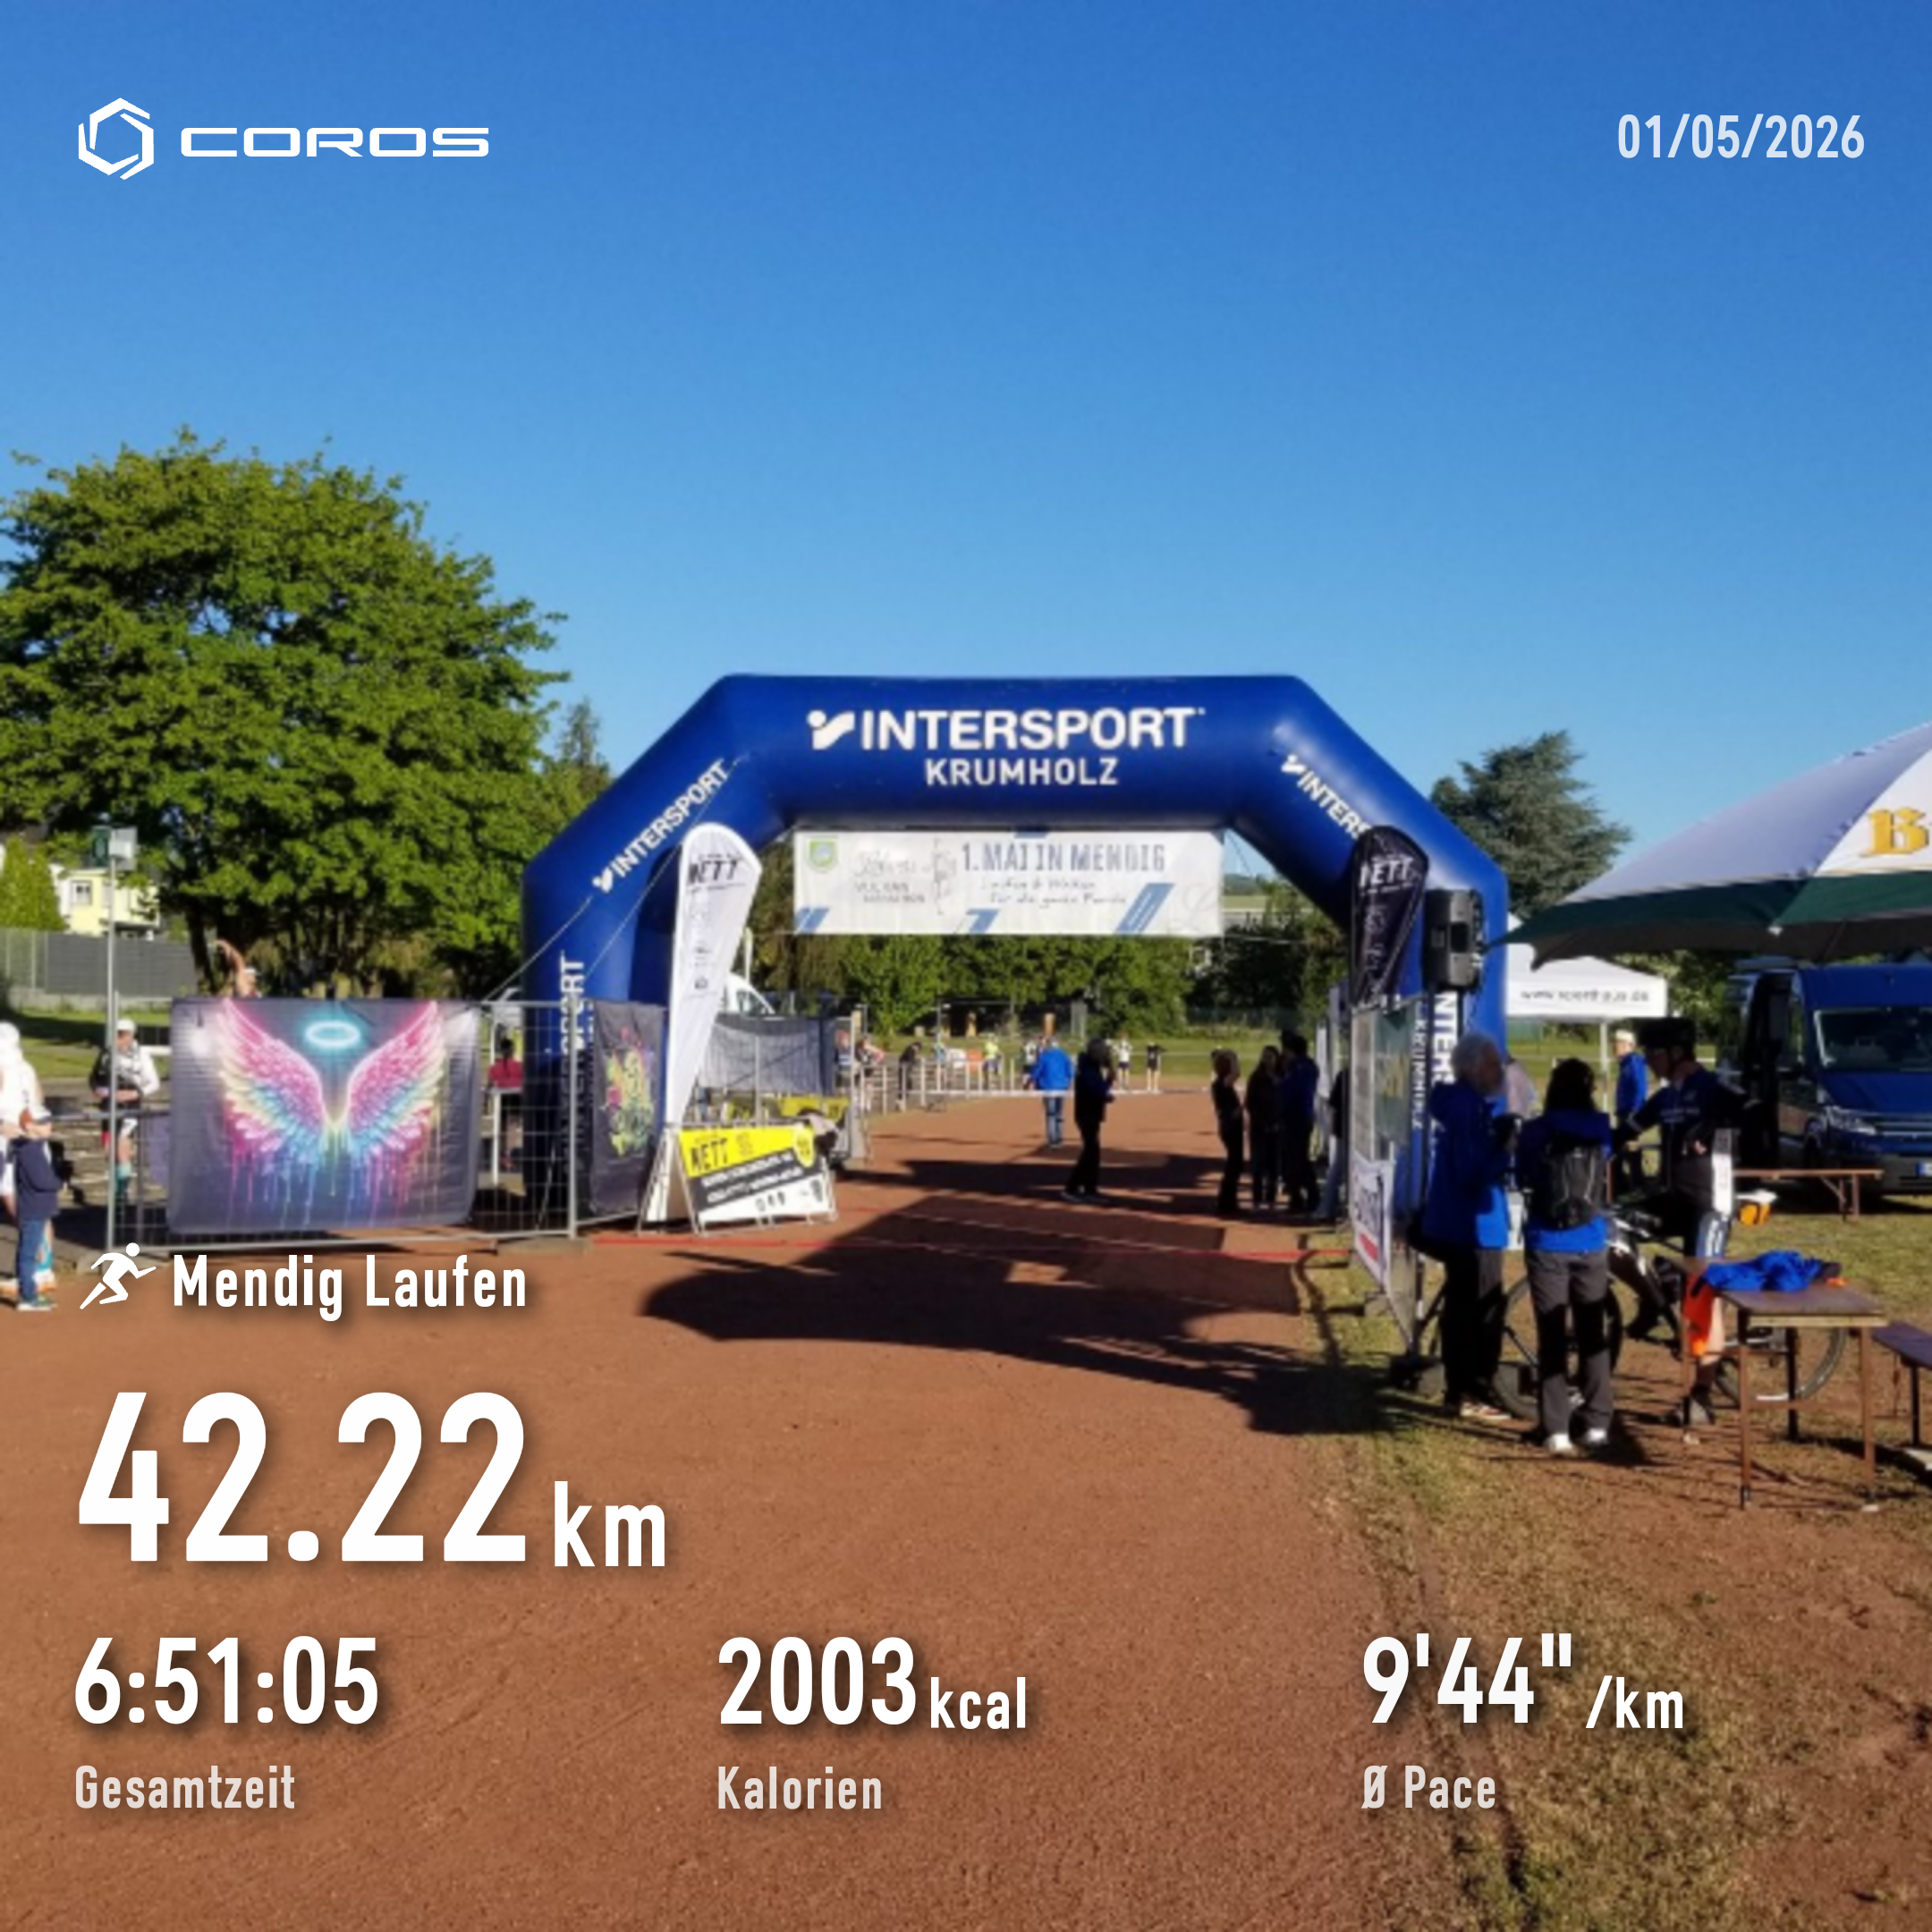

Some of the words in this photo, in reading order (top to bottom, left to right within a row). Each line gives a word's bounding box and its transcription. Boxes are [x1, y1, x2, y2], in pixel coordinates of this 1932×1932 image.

[861, 708, 1197, 750] INTERSPORT
[926, 758, 1118, 785] KRUMHOLZ
[610, 758, 728, 878] INTERSPORT
[1863, 807, 1932, 857] B
[1071, 844, 1165, 872] MENDIG
